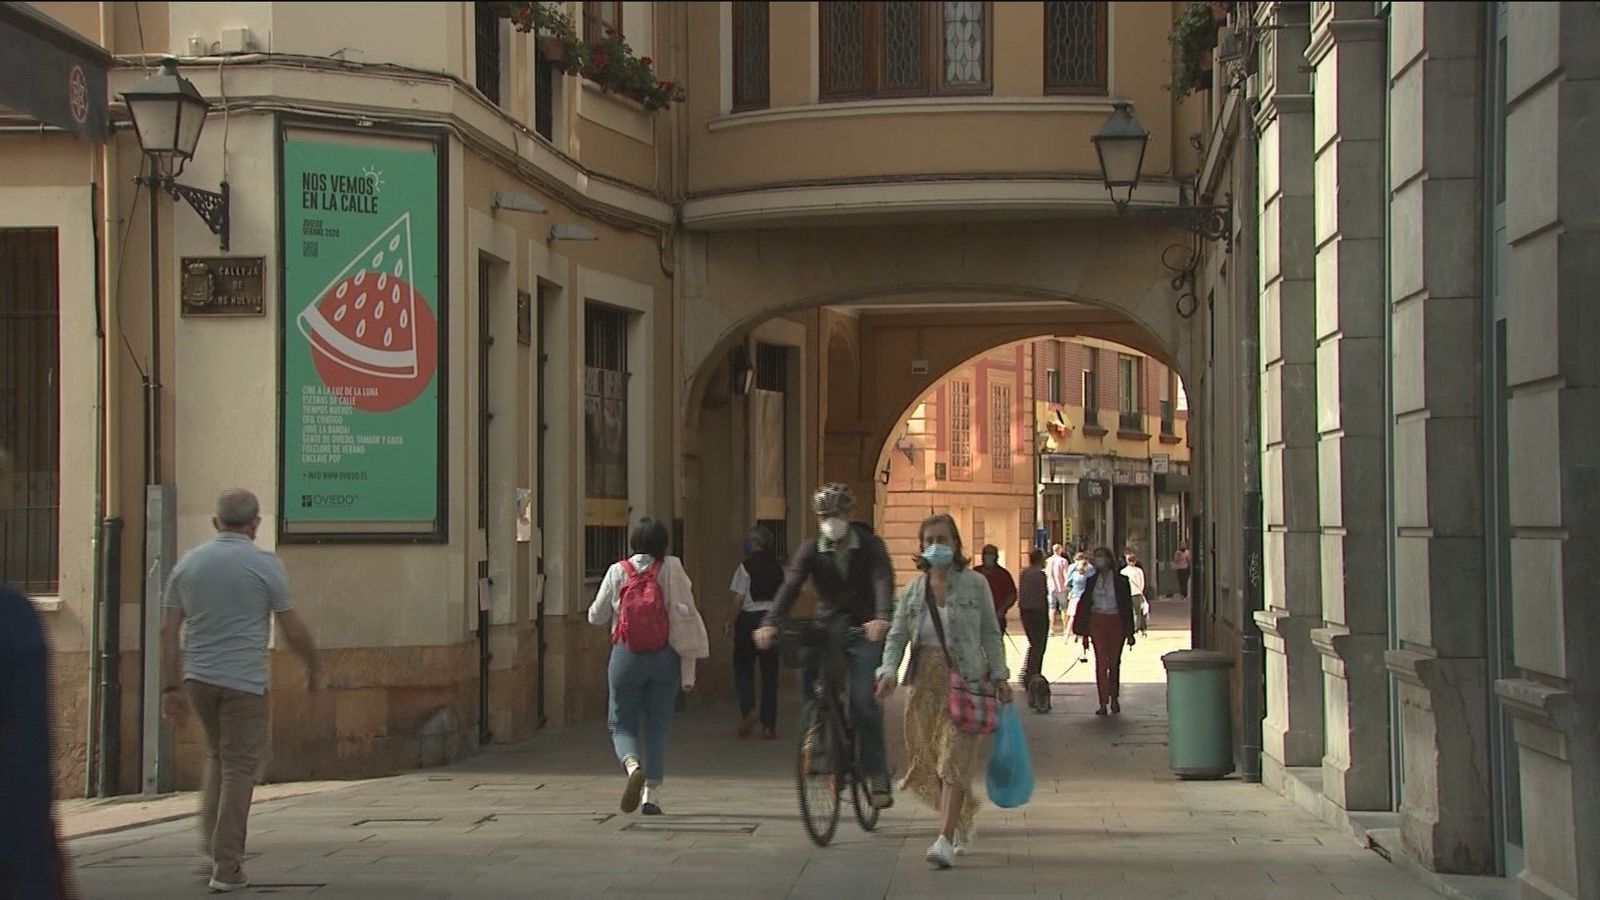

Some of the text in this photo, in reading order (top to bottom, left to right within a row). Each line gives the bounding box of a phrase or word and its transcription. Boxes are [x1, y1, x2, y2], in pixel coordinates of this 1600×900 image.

[303, 172, 374, 195] NOS VEMOS
[303, 192, 378, 214] EN LA CALLE
[219, 267, 258, 276] CALLEJA
[232, 280, 242, 289] DE
[303, 386, 378, 396] CINE A LA LUZ DE LA LUNA
[303, 396, 355, 405] ESCENAS DE CALLE
[303, 405, 352, 415] TIEMPOS NUEVOS
[317, 415, 343, 425] CONTIGO
[319, 425, 327, 434] LA
[303, 434, 321, 443] GENTE
[322, 435, 330, 444] DE
[387, 436, 404, 445] GAITA
[332, 445, 340, 453] DE
[341, 445, 365, 454] VERANO
[303, 454, 341, 463] ENCLAVE POP
[308, 471, 321, 480] INFO
